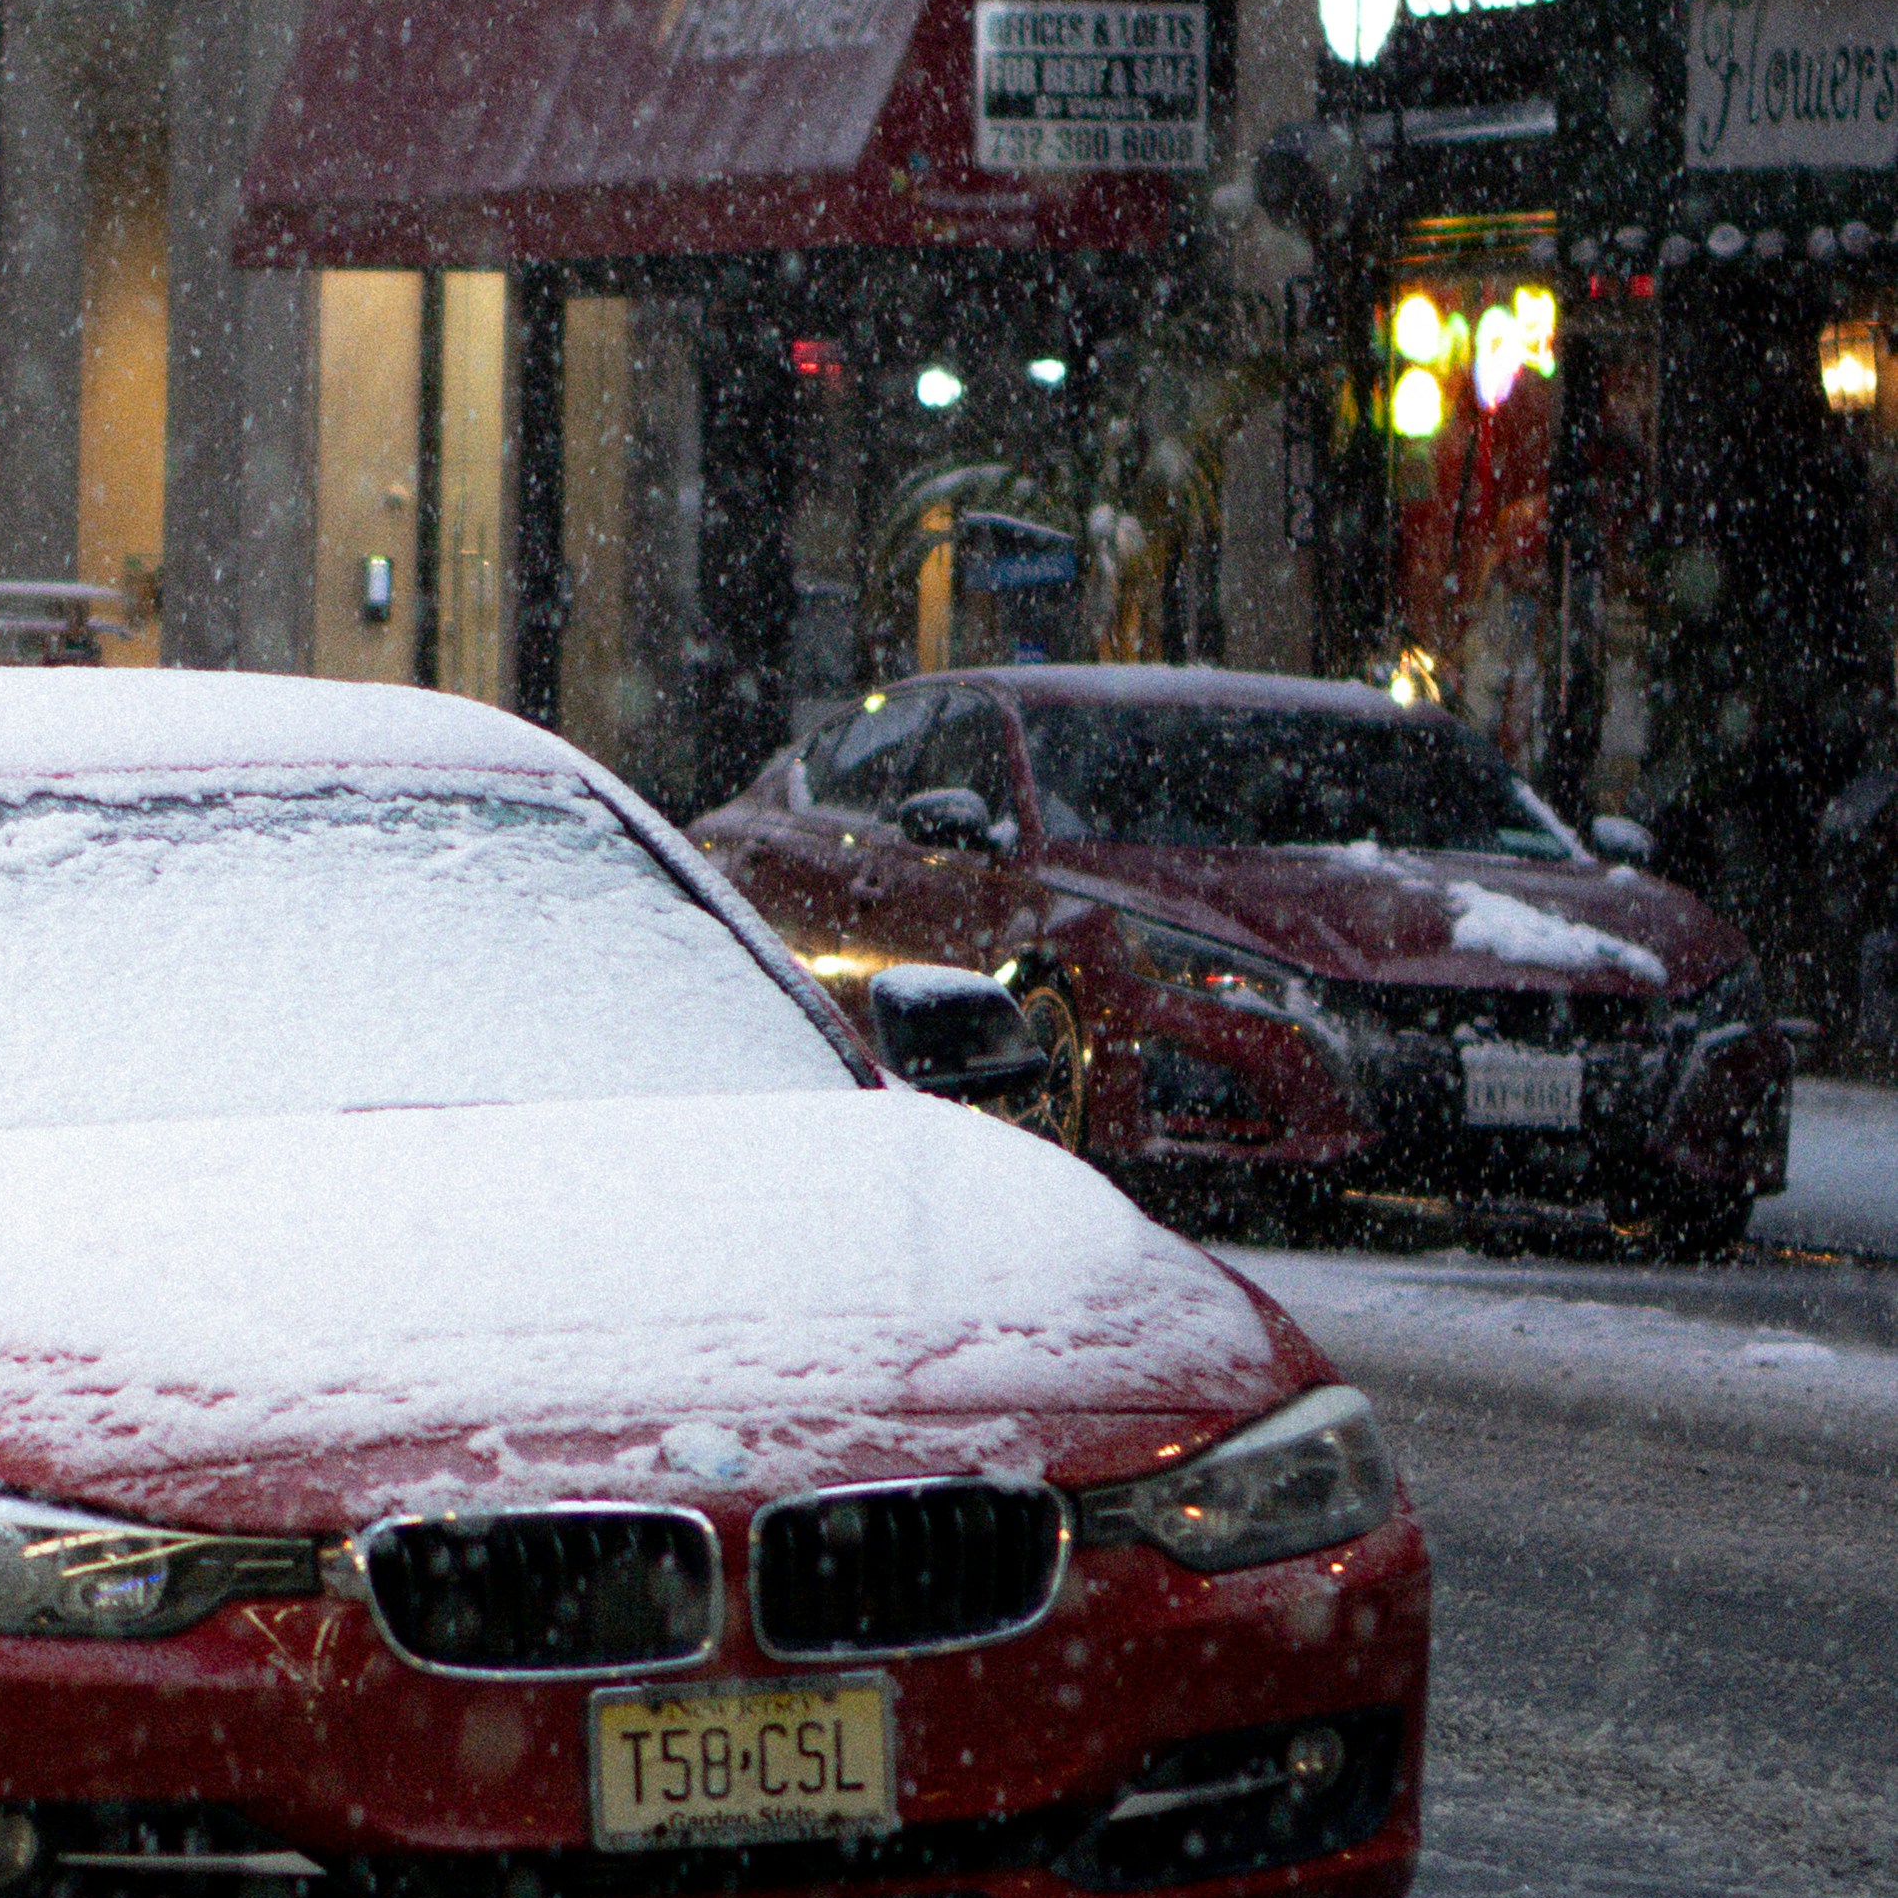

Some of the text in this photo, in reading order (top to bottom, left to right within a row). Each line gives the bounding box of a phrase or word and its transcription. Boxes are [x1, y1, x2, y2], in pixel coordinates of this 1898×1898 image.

[987, 57, 1037, 94] FOR
[1042, 58, 1107, 94] RENT
[1133, 57, 1199, 95] SALE
